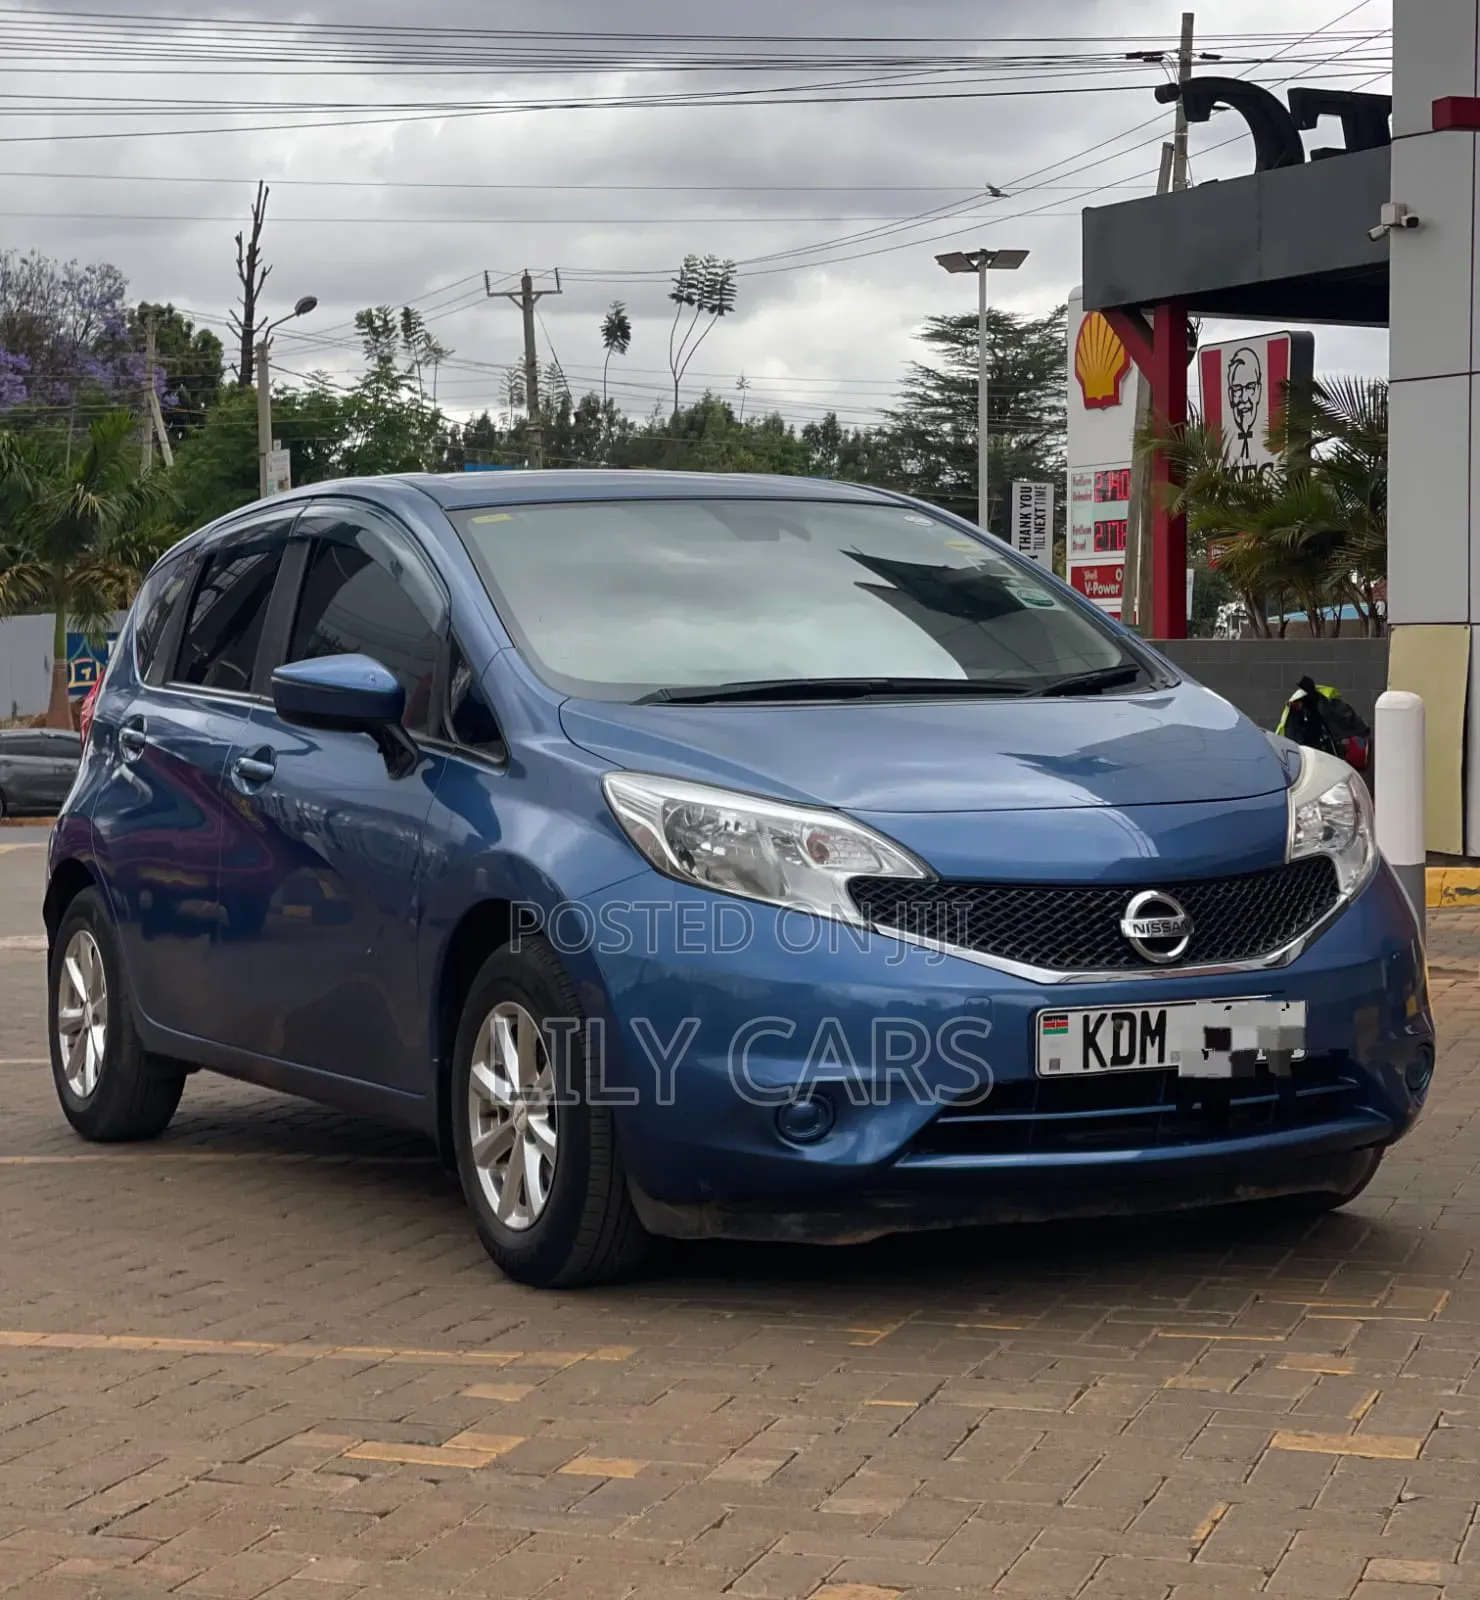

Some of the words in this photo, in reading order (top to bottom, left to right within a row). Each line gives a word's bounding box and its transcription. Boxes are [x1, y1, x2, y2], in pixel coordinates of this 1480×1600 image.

[1019, 486, 1032, 509] YOU
[1034, 485, 1047, 505] TIME
[1033, 507, 1046, 534] NEXT
[1019, 512, 1032, 551] THANK
[1033, 536, 1046, 550] TILL
[1084, 581, 1120, 595] V-Power
[1132, 920, 1189, 935] NISSAN
[1082, 1009, 1168, 1070] KDM
